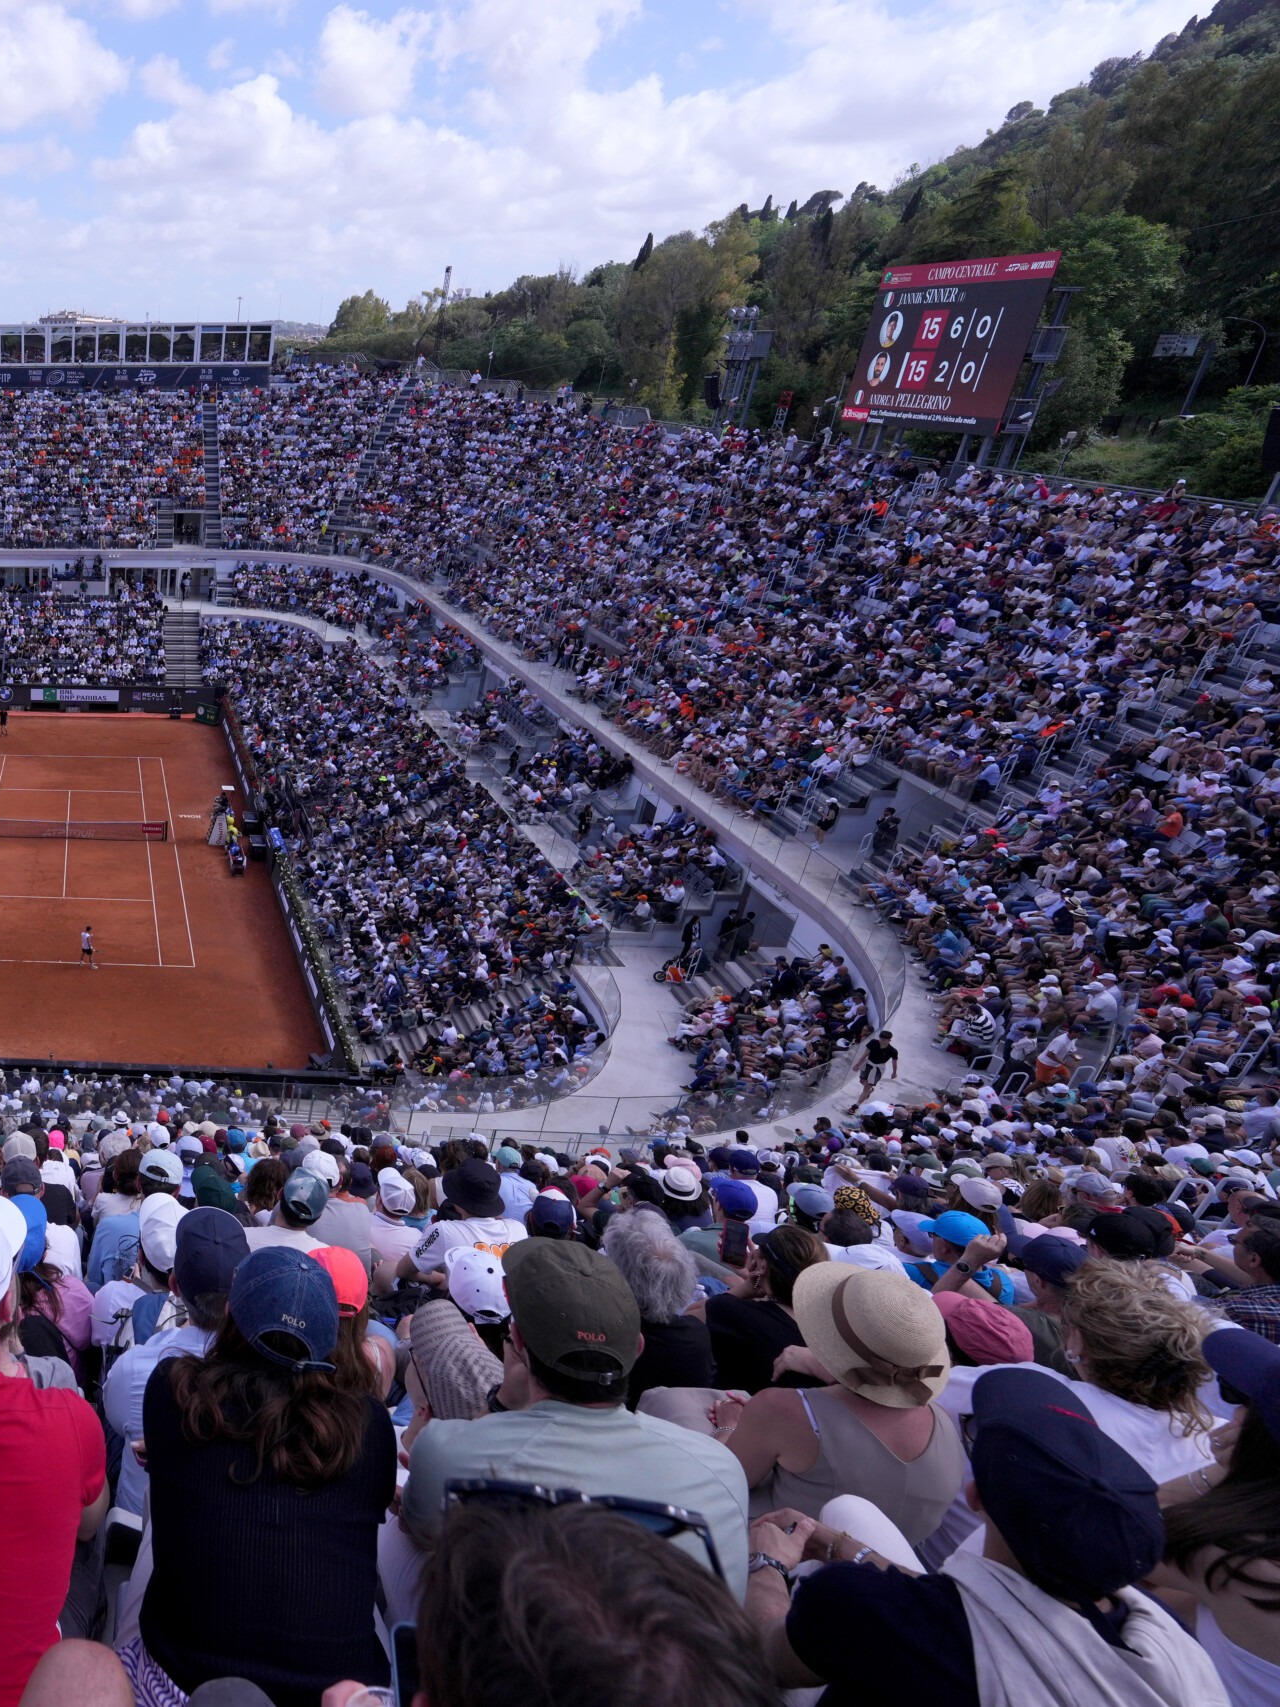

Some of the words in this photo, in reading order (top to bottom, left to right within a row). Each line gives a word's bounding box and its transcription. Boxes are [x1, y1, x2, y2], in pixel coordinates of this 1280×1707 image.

[928, 266, 955, 281] CAMPO
[955, 262, 998, 280] CENTRALE
[897, 292, 924, 308] JANNIK
[924, 288, 959, 304] SINNER
[922, 317, 942, 339] 15
[950, 316, 964, 338] 6
[976, 315, 991, 338] 0
[133, 373, 156, 381] ATP
[908, 360, 928, 381] 15
[934, 361, 949, 382] 2
[960, 361, 975, 383] 0
[868, 394, 894, 406] ANDREA
[894, 393, 952, 410] PELLEGRINO
[69, 830, 95, 838] TOUR
[281, 1314, 306, 1329] POLO
[577, 1332, 606, 1342] POLO
